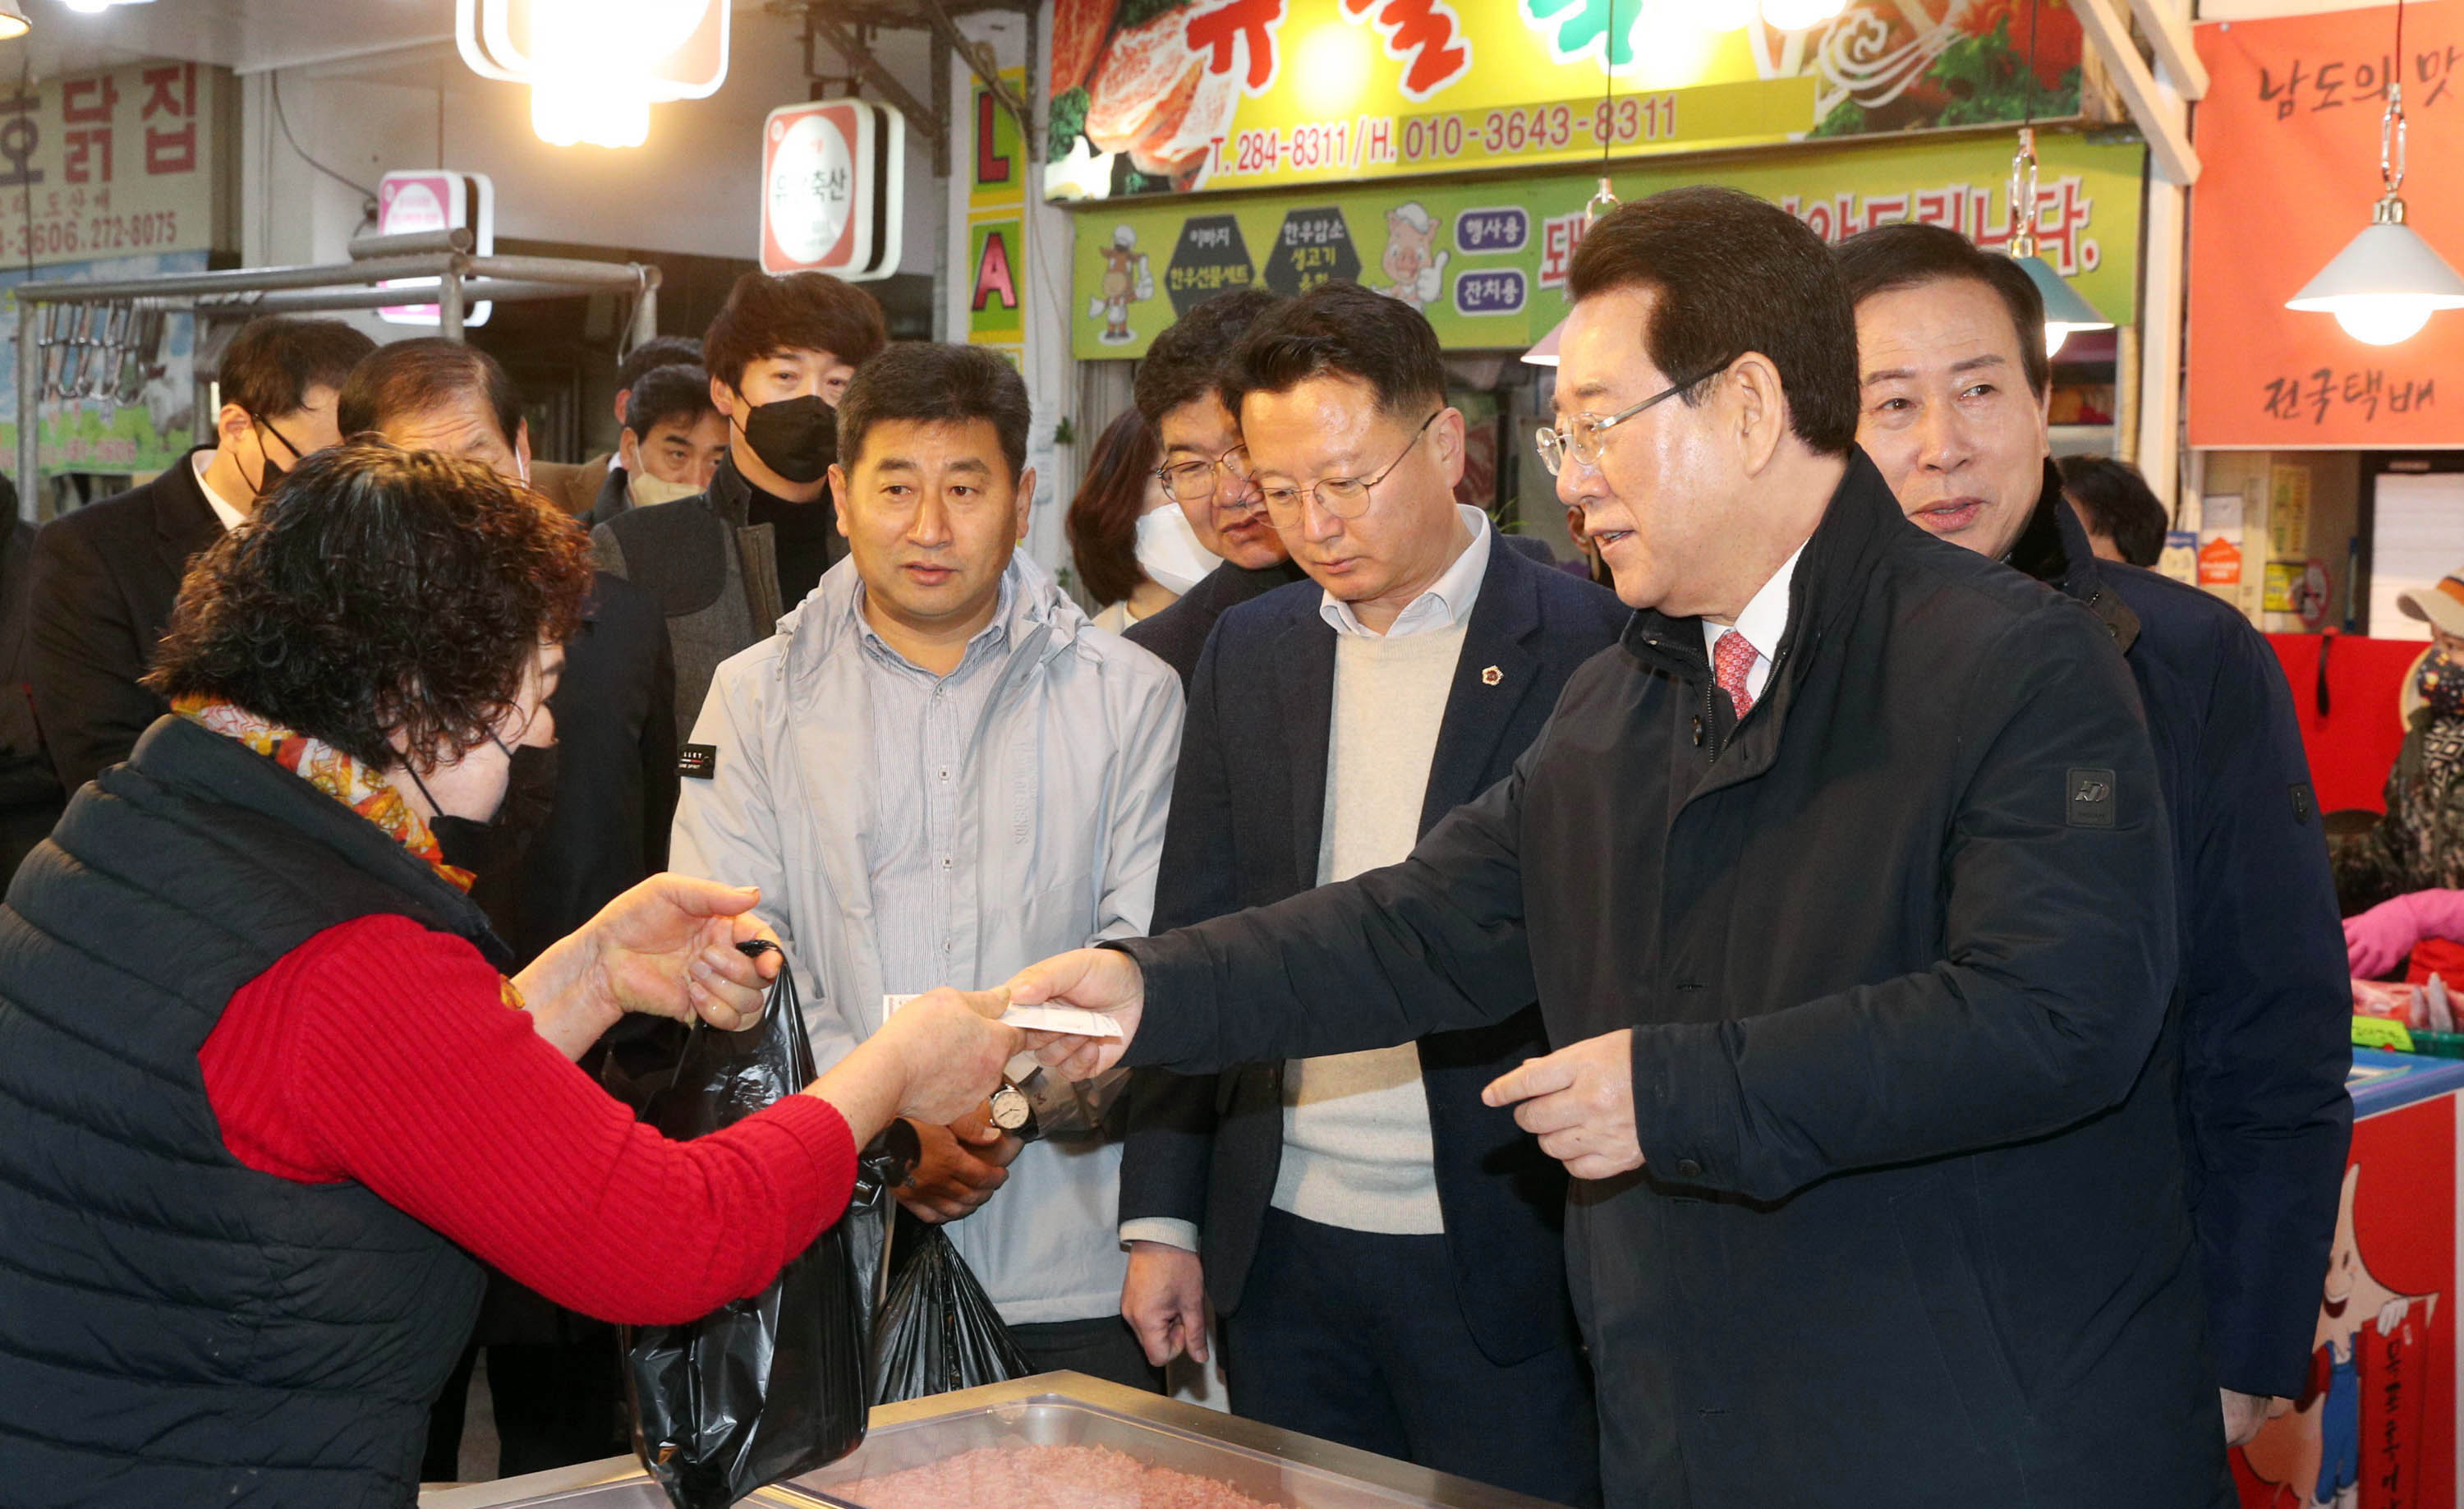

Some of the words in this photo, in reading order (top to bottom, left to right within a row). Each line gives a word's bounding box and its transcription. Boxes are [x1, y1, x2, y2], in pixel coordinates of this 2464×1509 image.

[2259, 55, 2391, 121] 남도의
[2416, 46, 2464, 108] 맛
[1405, 94, 1676, 159] 010-3643-8311
[1284, 219, 1345, 246] 한우암소
[1464, 215, 1521, 245] 행사용
[1541, 217, 1588, 283] 돼
[1784, 183, 2095, 268] 아드립니다.
[1170, 264, 1249, 290] 한우선물세트
[1464, 278, 1519, 306] 잔치용
[2264, 367, 2435, 425] 전국택배
